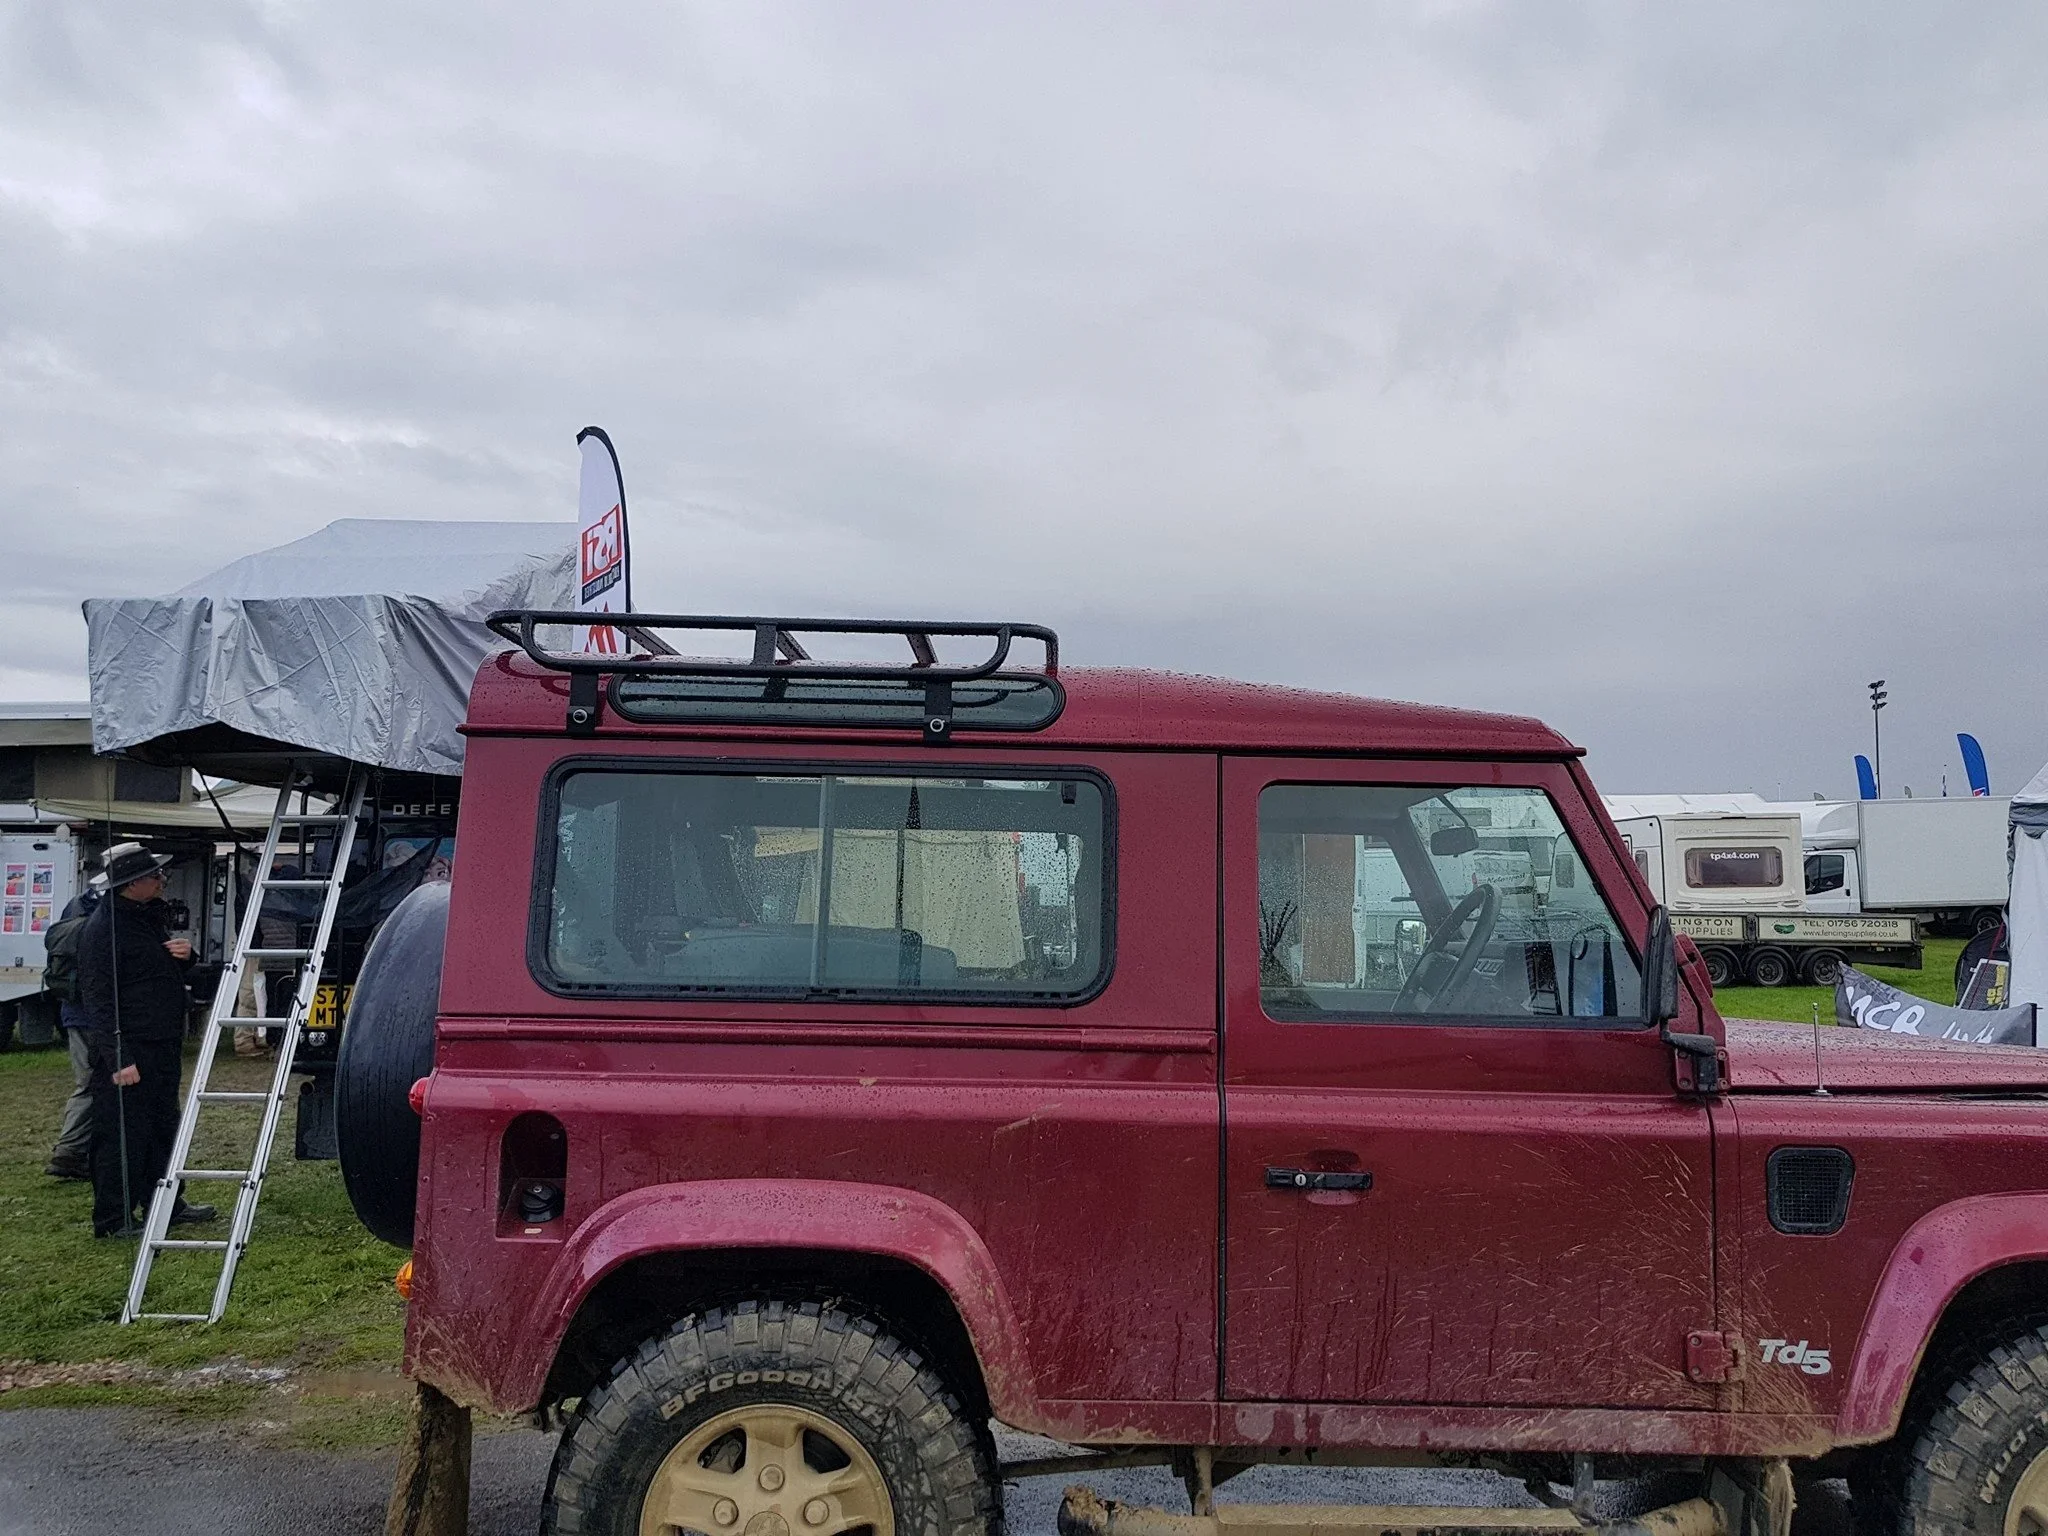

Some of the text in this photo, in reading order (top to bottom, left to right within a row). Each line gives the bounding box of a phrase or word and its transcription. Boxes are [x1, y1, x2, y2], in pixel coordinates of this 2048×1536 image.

[392, 804, 451, 815] DEFE
[1710, 852, 1760, 861] tp4x4.com
[1802, 919, 1825, 928] TEL:
[1827, 919, 1858, 928] 01756
[1861, 919, 1899, 928] 720318
[1681, 926, 1734, 936] SUPPLIES
[1758, 1338, 1832, 1375] Td5
